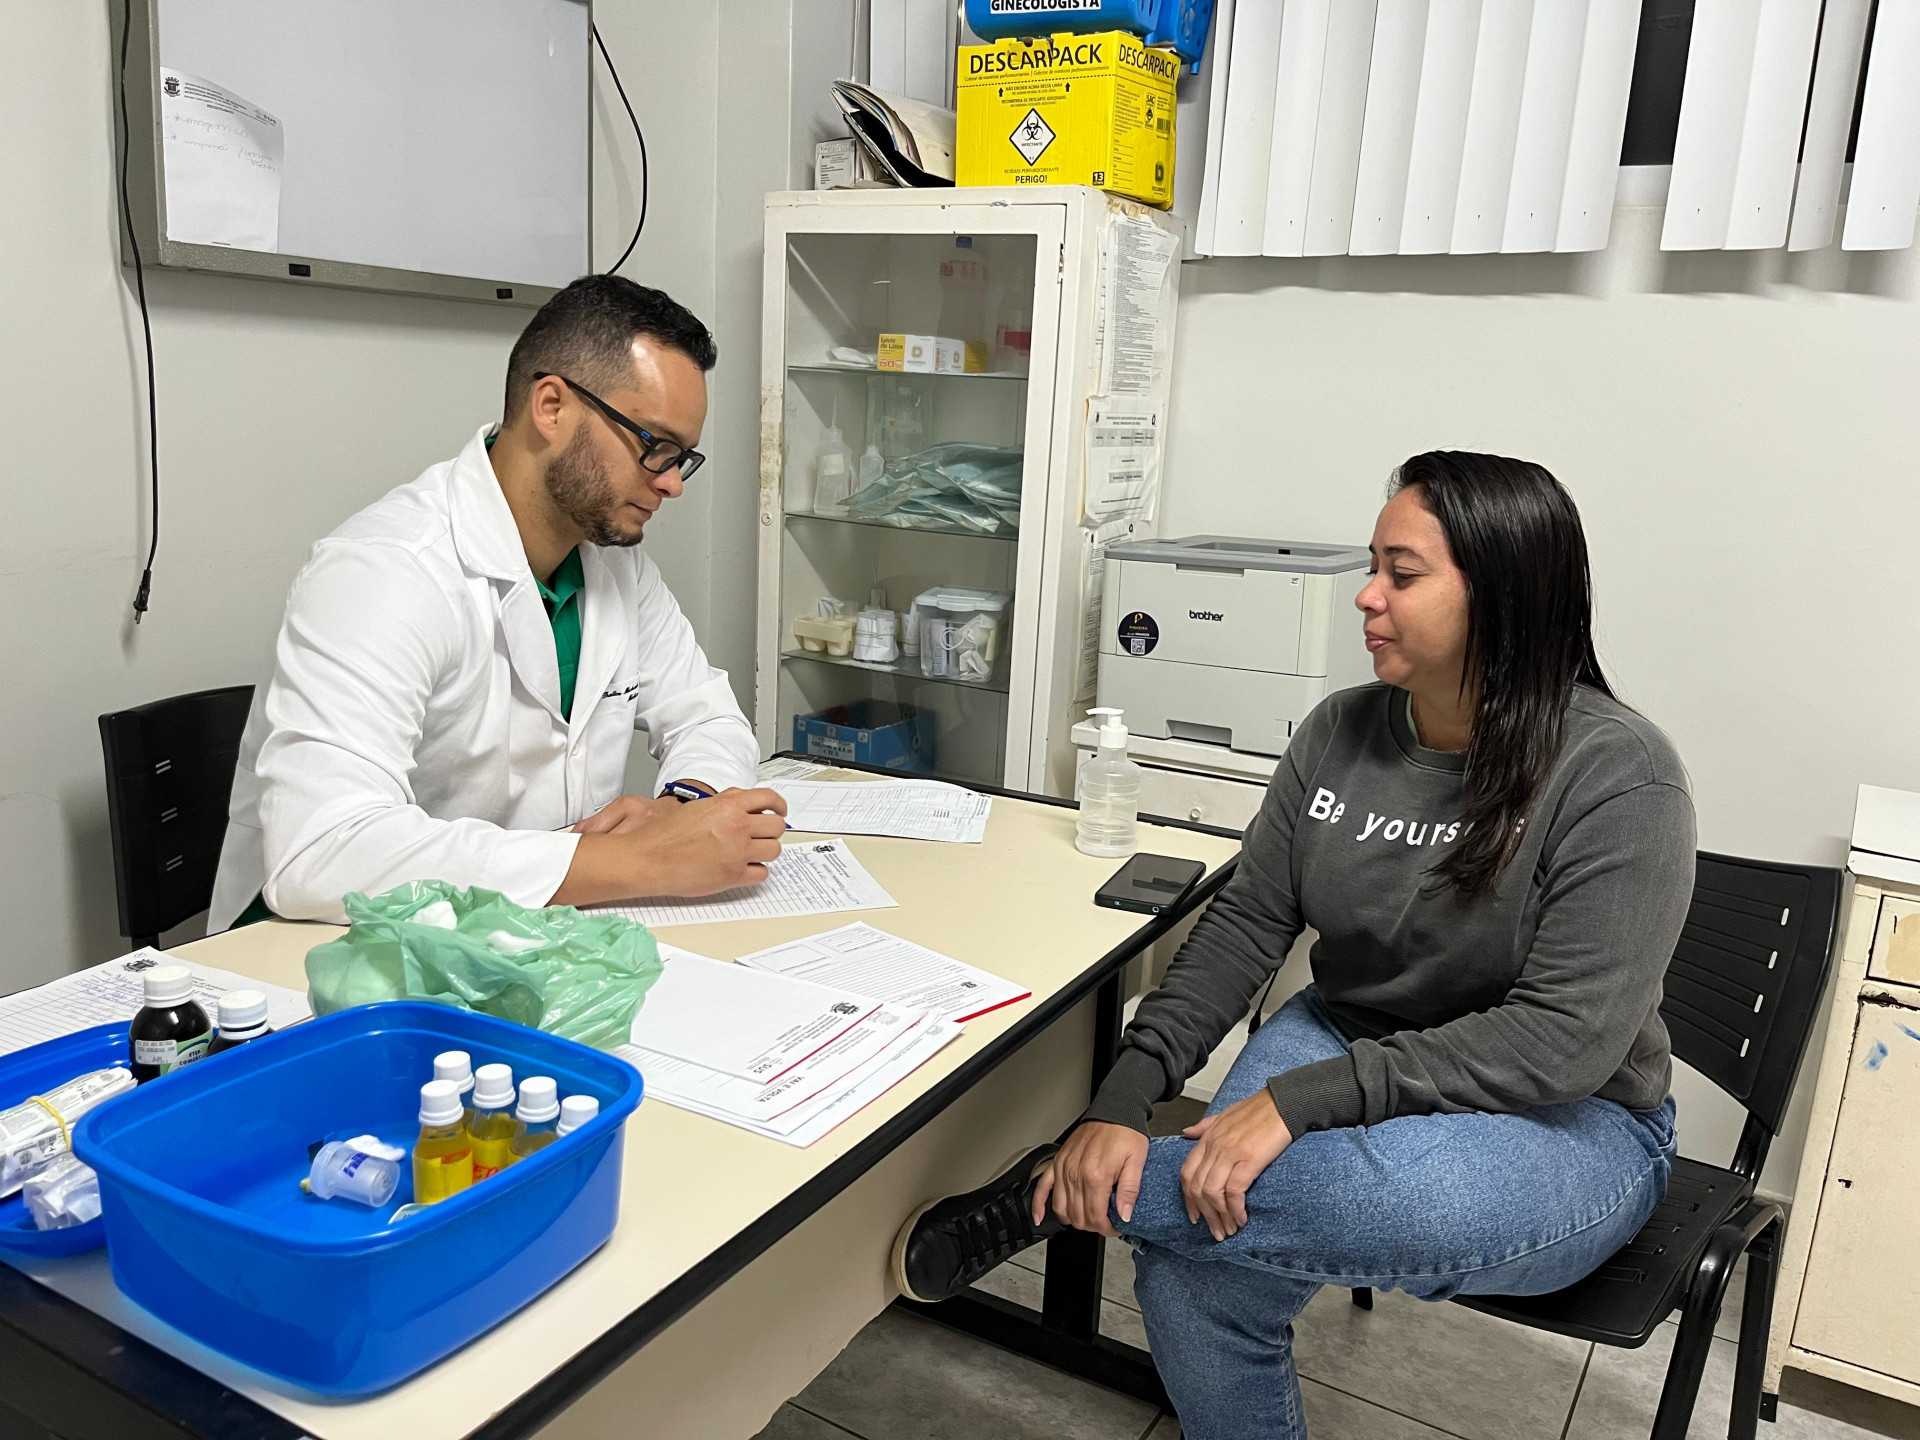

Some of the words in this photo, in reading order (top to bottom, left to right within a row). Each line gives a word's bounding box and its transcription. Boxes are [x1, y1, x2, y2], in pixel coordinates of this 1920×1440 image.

[991, 0, 1099, 11] GINECOLOGISTA
[970, 43, 1102, 74] DESCARPACK
[1119, 44, 1177, 80] DESCARPACK
[1015, 174, 1048, 184] PERIGO!
[1093, 172, 1104, 181] 13
[1189, 609, 1223, 621] brother
[1307, 787, 1345, 824] Be
[1356, 812, 1524, 846] yours
